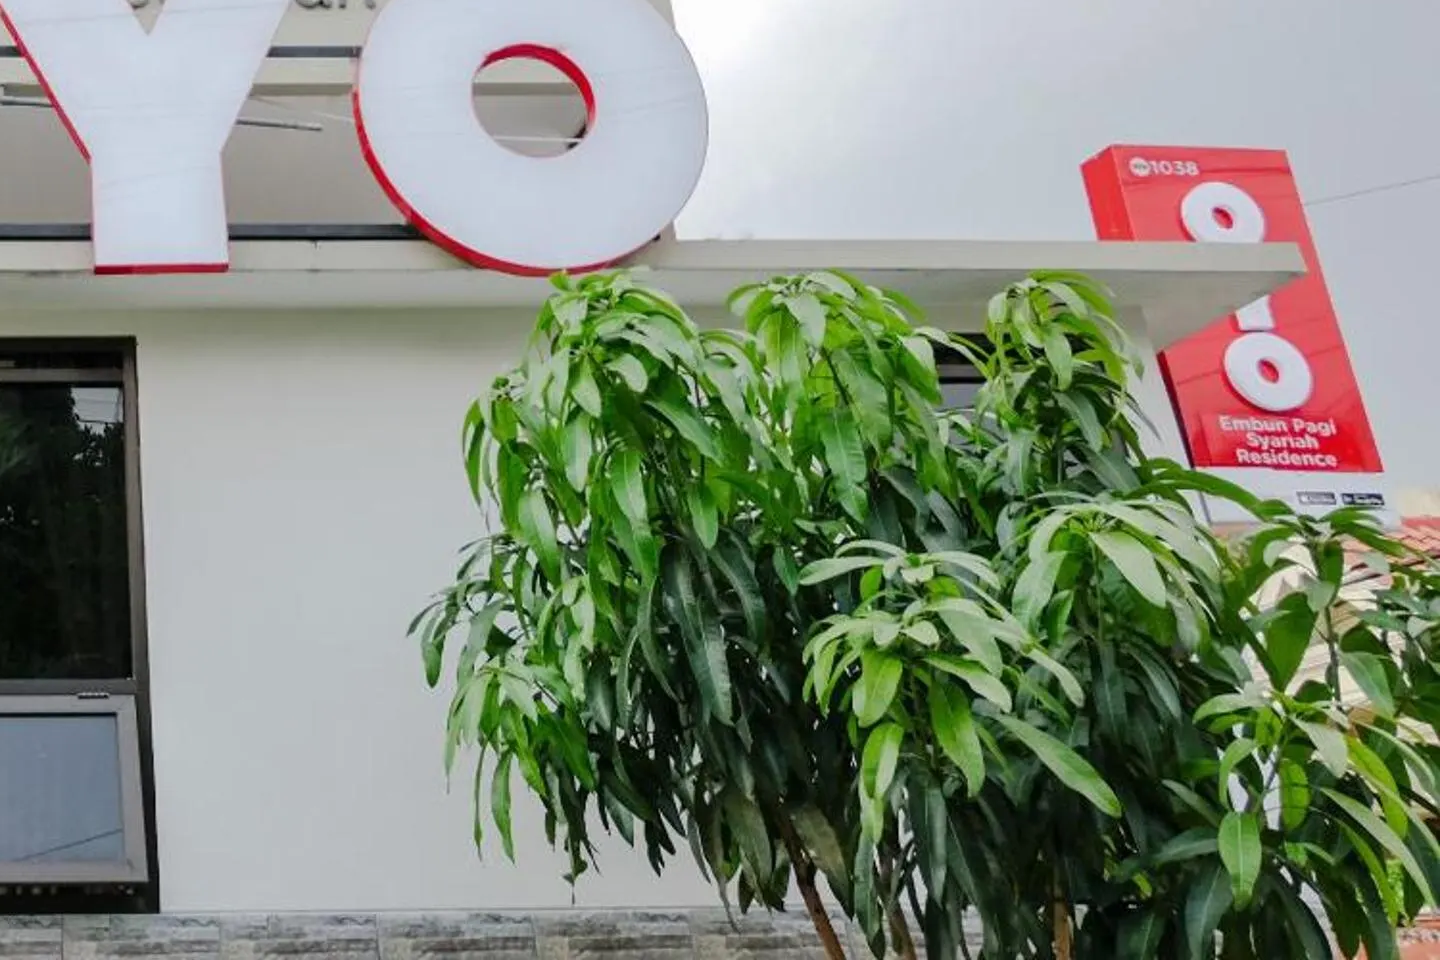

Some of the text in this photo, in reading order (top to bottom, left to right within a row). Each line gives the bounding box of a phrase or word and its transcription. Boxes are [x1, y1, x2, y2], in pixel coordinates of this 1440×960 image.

[1149, 160, 1200, 176] 1038
[1219, 416, 1337, 437] Embun Pagi
[1245, 432, 1319, 450] Syariah
[1236, 448, 1338, 467] Residence
